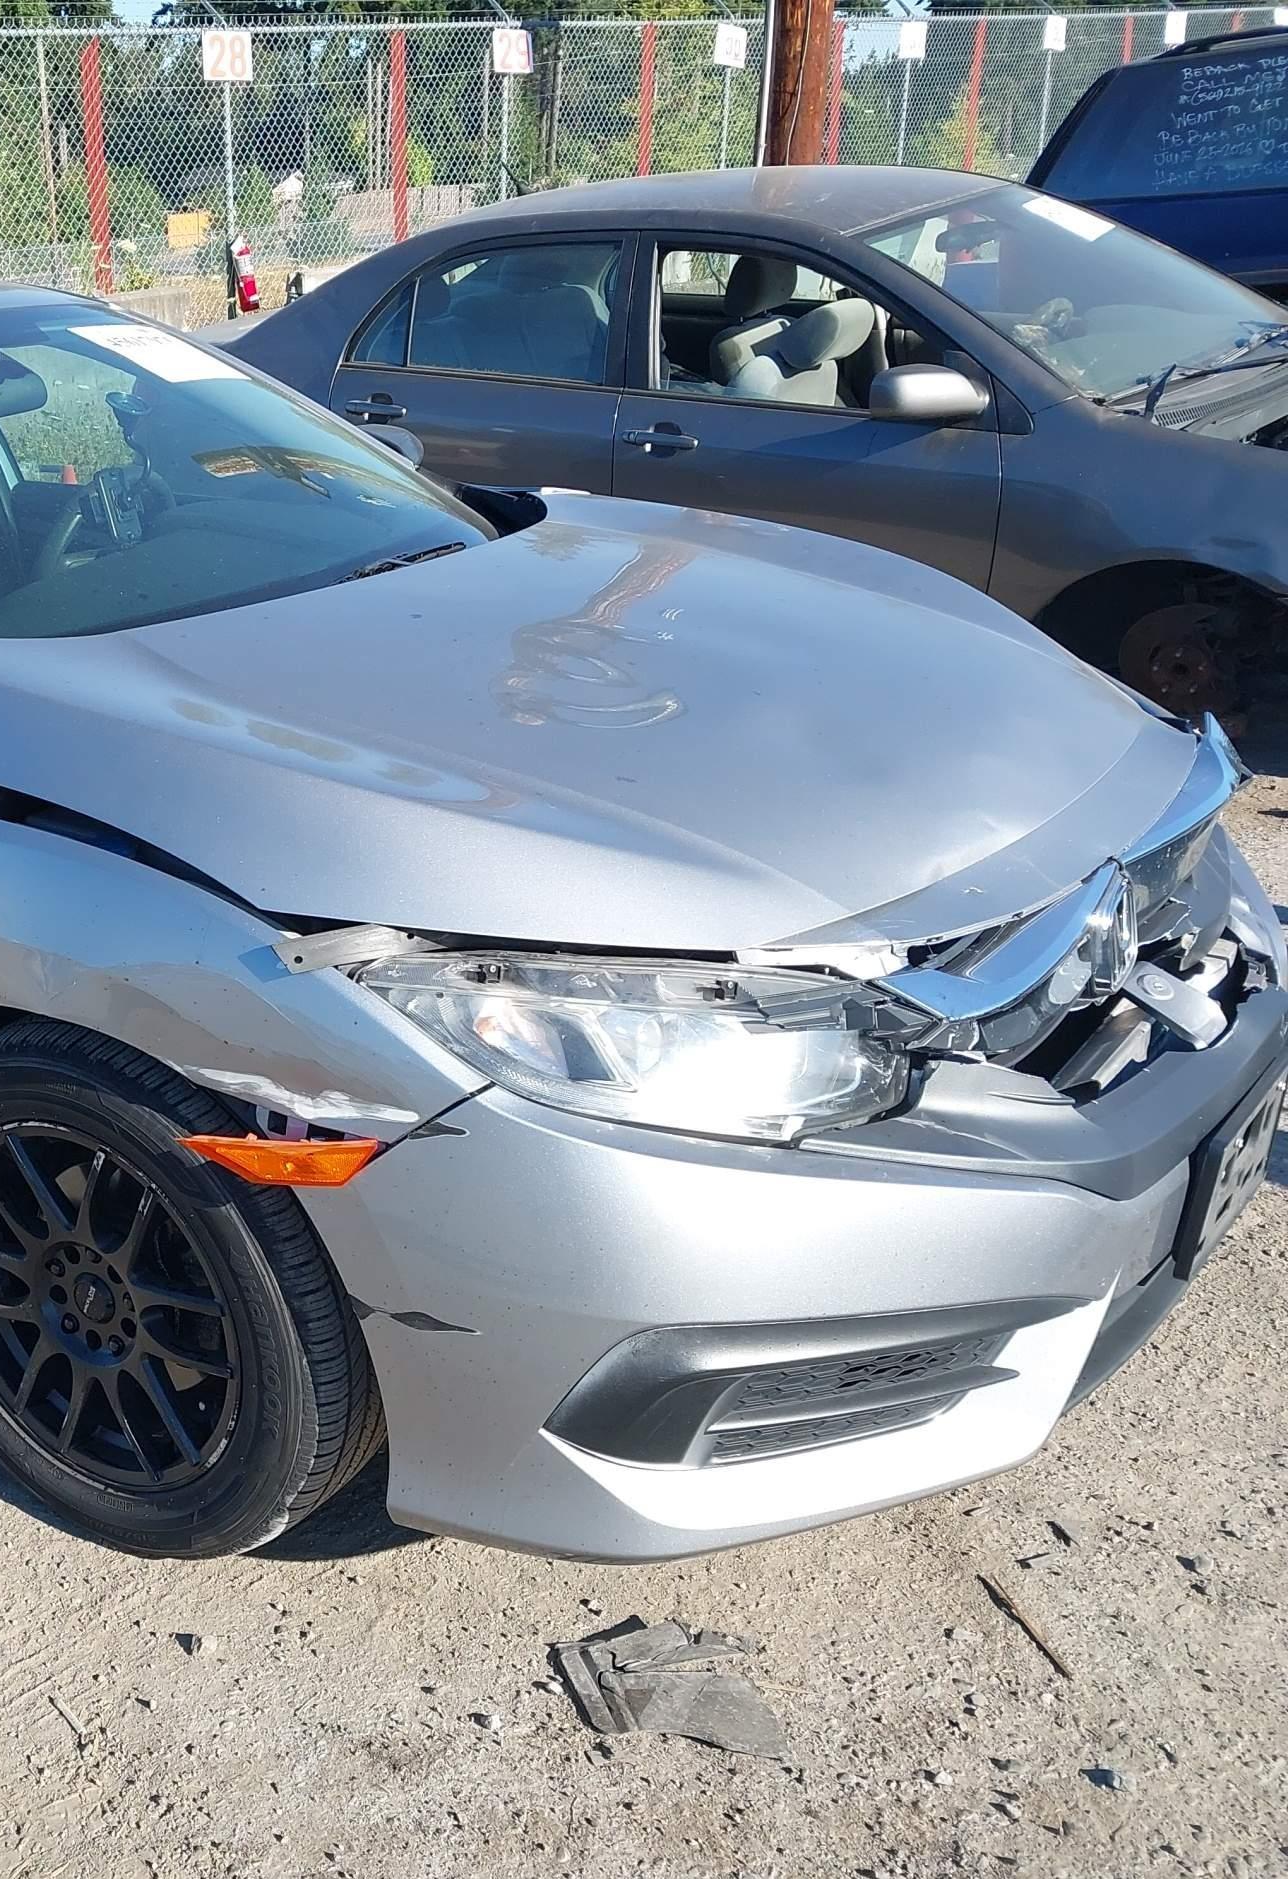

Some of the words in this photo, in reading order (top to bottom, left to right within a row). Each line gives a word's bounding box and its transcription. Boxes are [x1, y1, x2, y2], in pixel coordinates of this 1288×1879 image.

[210, 35, 247, 79] 28
[499, 32, 530, 70] 29
[1182, 78, 1235, 92] CALL
[1171, 110, 1218, 129] WENT
[1218, 105, 1241, 118] TO
